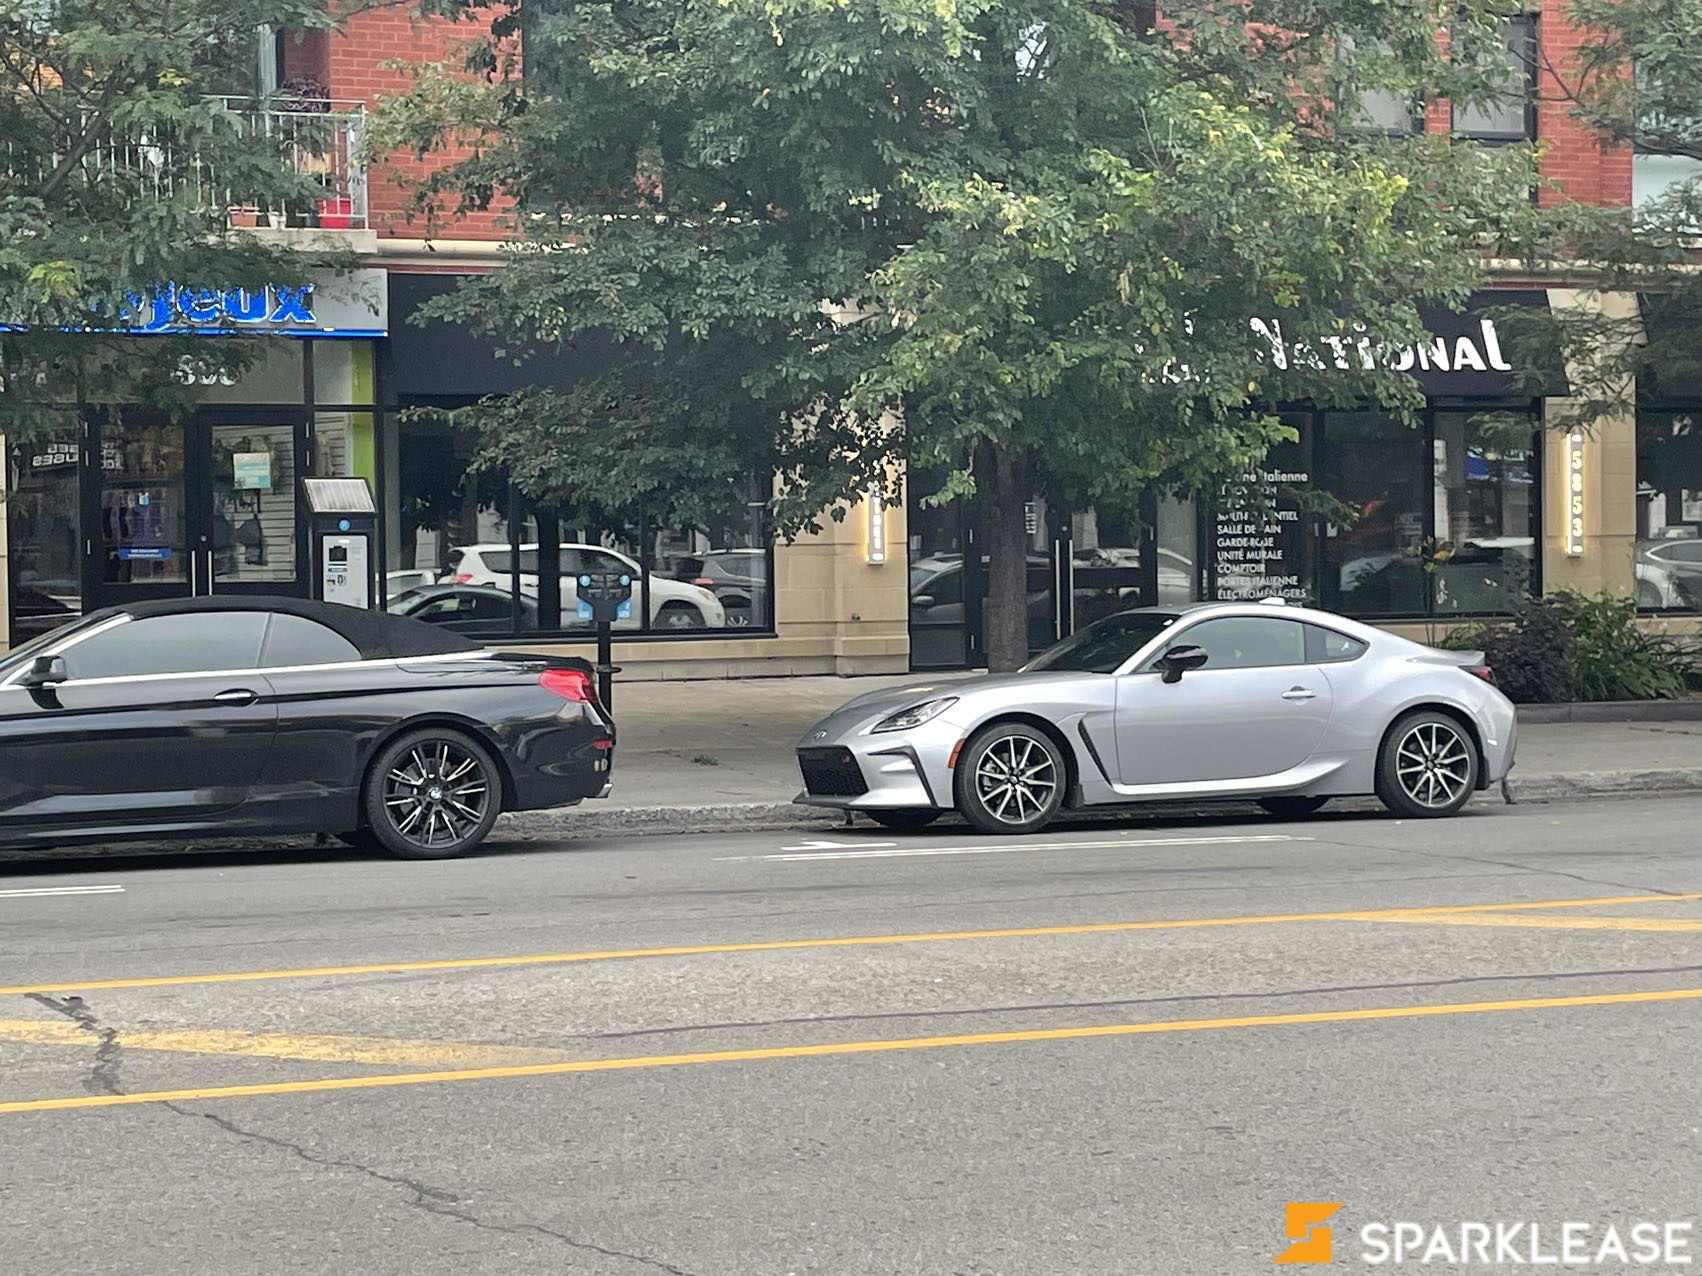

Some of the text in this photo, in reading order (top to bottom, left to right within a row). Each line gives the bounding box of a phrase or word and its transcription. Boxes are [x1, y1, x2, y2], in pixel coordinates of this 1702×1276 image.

[1217, 524, 1243, 535] SALLE
[1246, 549, 1283, 560] MURALE
[1217, 563, 1266, 574] COMPTOIR
